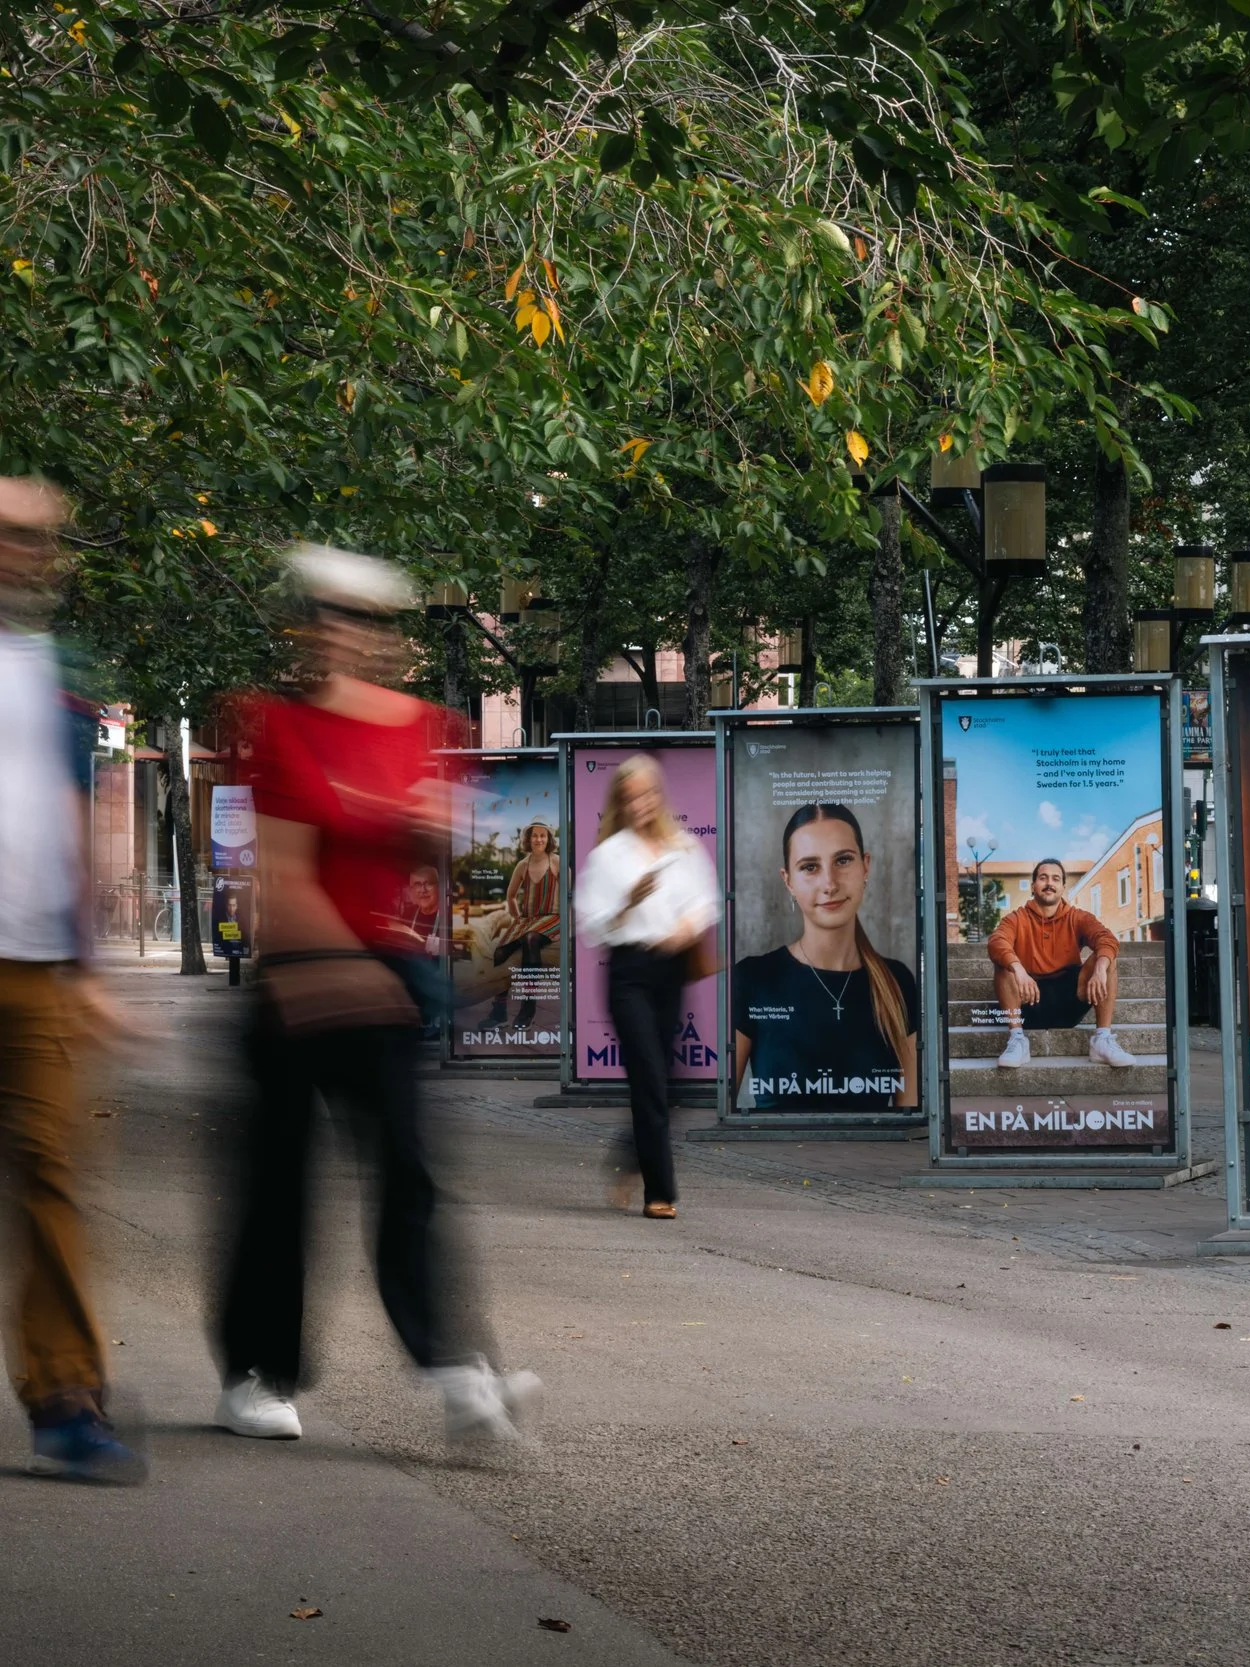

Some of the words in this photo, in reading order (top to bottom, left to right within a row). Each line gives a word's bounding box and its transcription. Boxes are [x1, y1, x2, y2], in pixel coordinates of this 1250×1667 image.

[1040, 749, 1060, 757] truly
[1036, 759, 1079, 767] Stockholm
[866, 769, 891, 778] helping
[1077, 769, 1094, 778] only
[1069, 780, 1081, 788] for
[464, 1032, 481, 1044] EN
[486, 1028, 502, 1044] PÅ
[505, 1032, 573, 1044] MILJON
[749, 1078, 774, 1095] EN
[779, 1073, 801, 1094] PÅ
[806, 1076, 905, 1094] MILJONEN
[966, 1111, 995, 1130] EN
[1002, 1105, 1029, 1130] PÅ
[1034, 1110, 1153, 1130] MILJONEN
